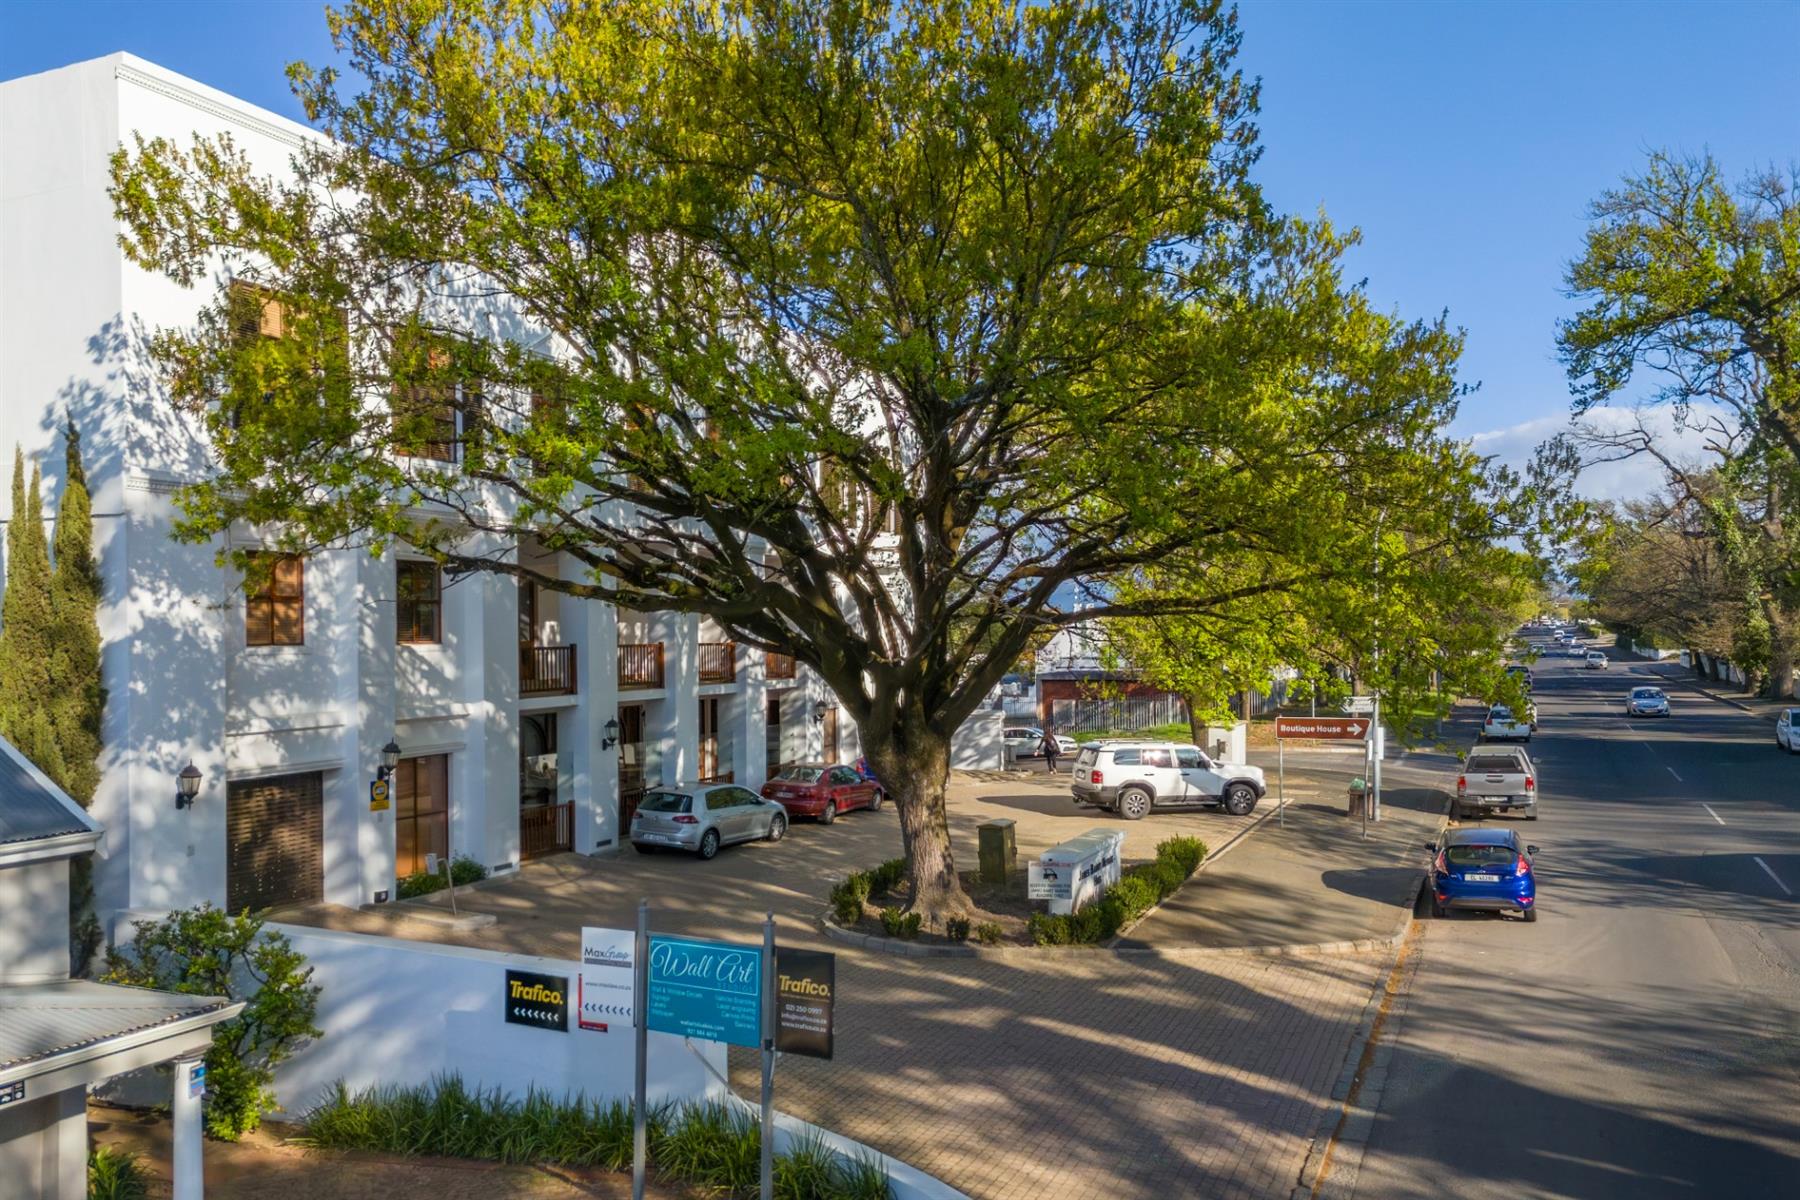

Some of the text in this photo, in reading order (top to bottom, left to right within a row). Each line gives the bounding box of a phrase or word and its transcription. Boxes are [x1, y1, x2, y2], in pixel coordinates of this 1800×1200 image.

[1280, 724, 1342, 734] Boutique House
[650, 943, 755, 984] Wall Art
